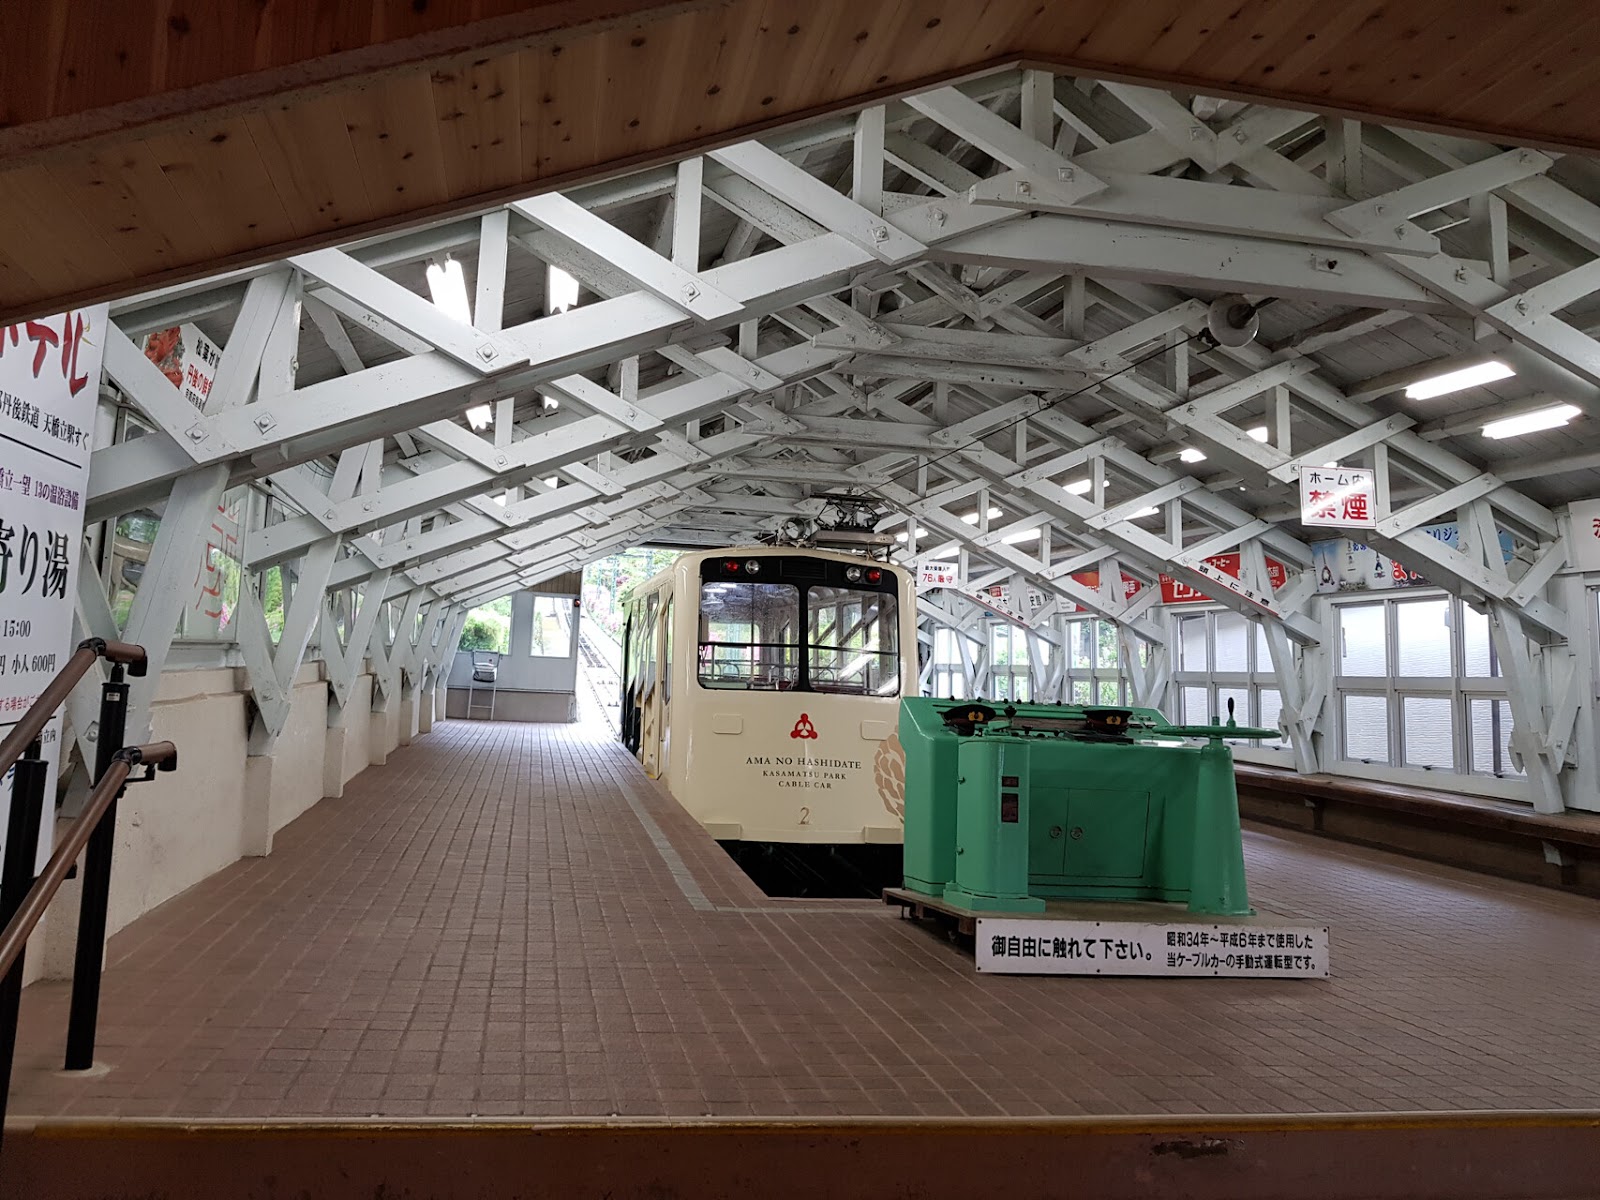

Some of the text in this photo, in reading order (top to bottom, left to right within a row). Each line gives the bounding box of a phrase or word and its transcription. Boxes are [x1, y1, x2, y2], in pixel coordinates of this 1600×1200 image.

[0, 311, 89, 398] テル
[43, 411, 90, 451] 天橋立駅すぐ
[1309, 490, 1369, 521] 禁煙
[1198, 564, 1270, 607] 頭上に注意
[3, 619, 32, 638] 15:00
[746, 757, 862, 769] AMA NO HASHIDATE
[762, 770, 847, 780] KASAMATSU PARK
[799, 806, 810, 825] 2
[991, 935, 1152, 961] 御自由に触れて下さい。
